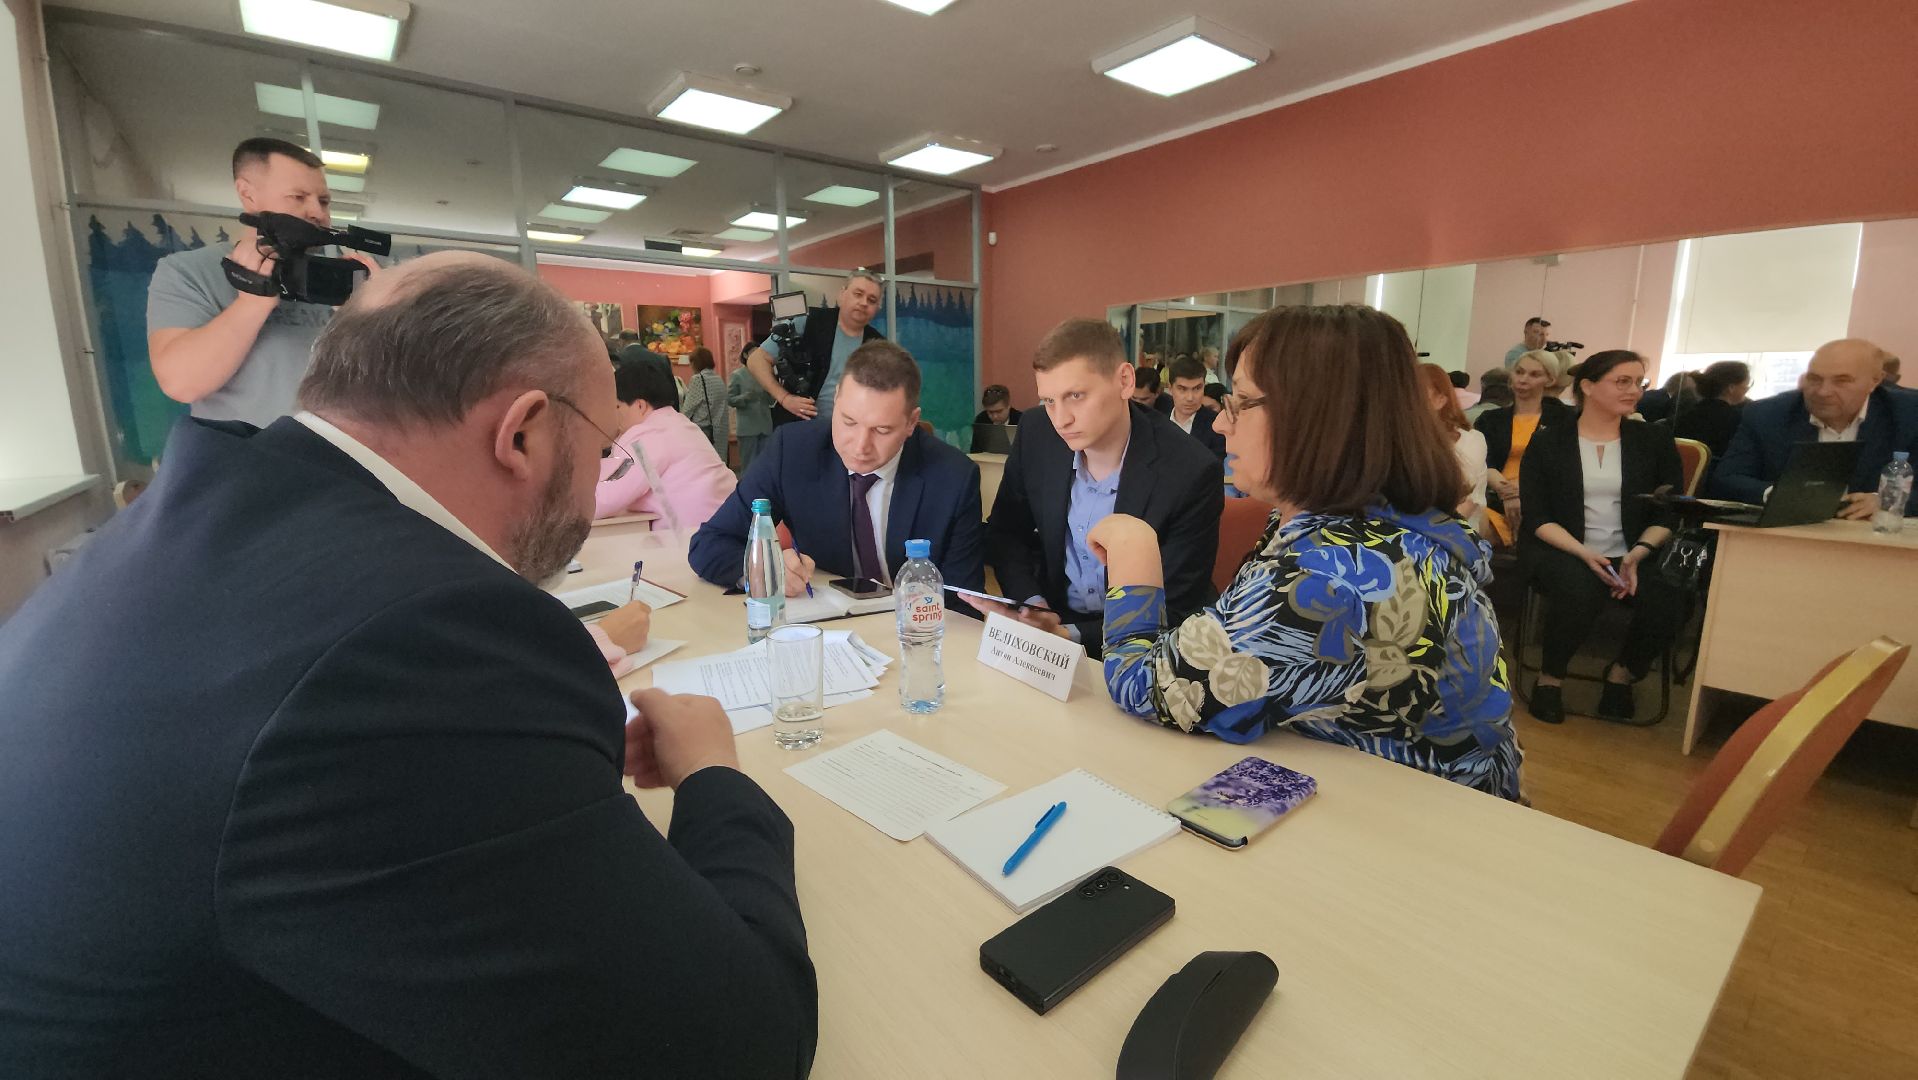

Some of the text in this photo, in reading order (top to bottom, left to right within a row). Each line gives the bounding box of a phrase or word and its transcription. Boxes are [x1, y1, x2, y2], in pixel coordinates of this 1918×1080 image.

[912, 610, 942, 623] spring
[916, 602, 940, 612] saint
[988, 626, 1070, 670] ВЕЛИХОВСКИЙ
[990, 645, 1056, 681] Антон Алексеевич
